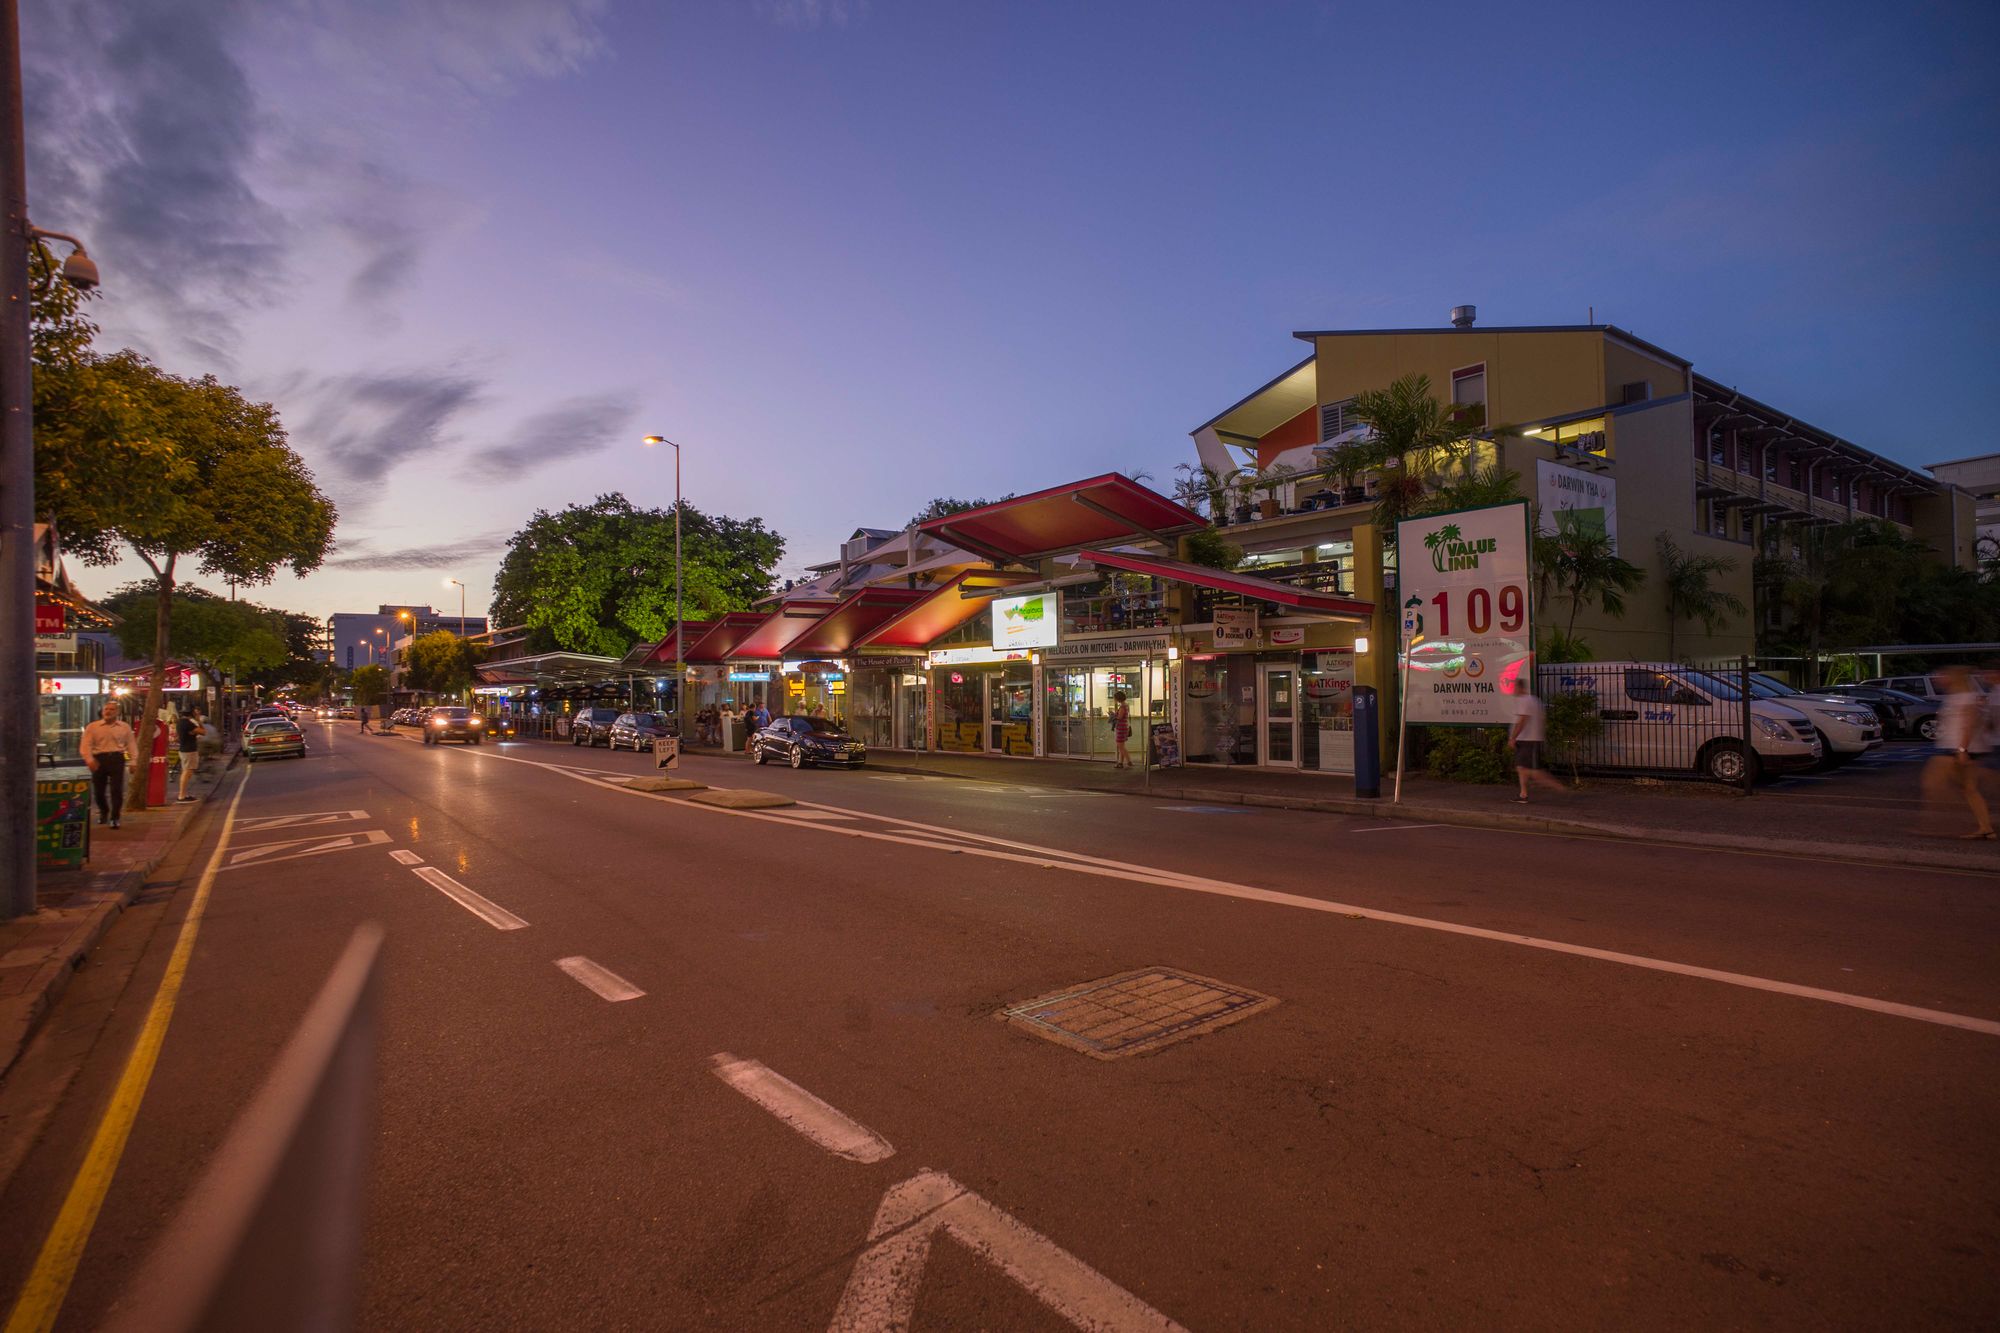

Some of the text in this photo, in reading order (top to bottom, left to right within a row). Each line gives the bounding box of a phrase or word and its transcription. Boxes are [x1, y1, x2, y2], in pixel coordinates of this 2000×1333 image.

[1558, 473, 1599, 497] DARWIN YHA
[1447, 538, 1496, 556] VALUE
[1448, 555, 1478, 571] INN
[1048, 645, 1079, 655] MELALEUCA
[1080, 646, 1089, 654] ON
[1090, 643, 1118, 653] MITCHELL
[1124, 641, 1150, 651] DARWIN
[1152, 640, 1167, 649] YHA
[1326, 659, 1352, 667] AATKings
[1308, 678, 1350, 691] AATKings
[1433, 682, 1494, 693] DARWIN YHA
